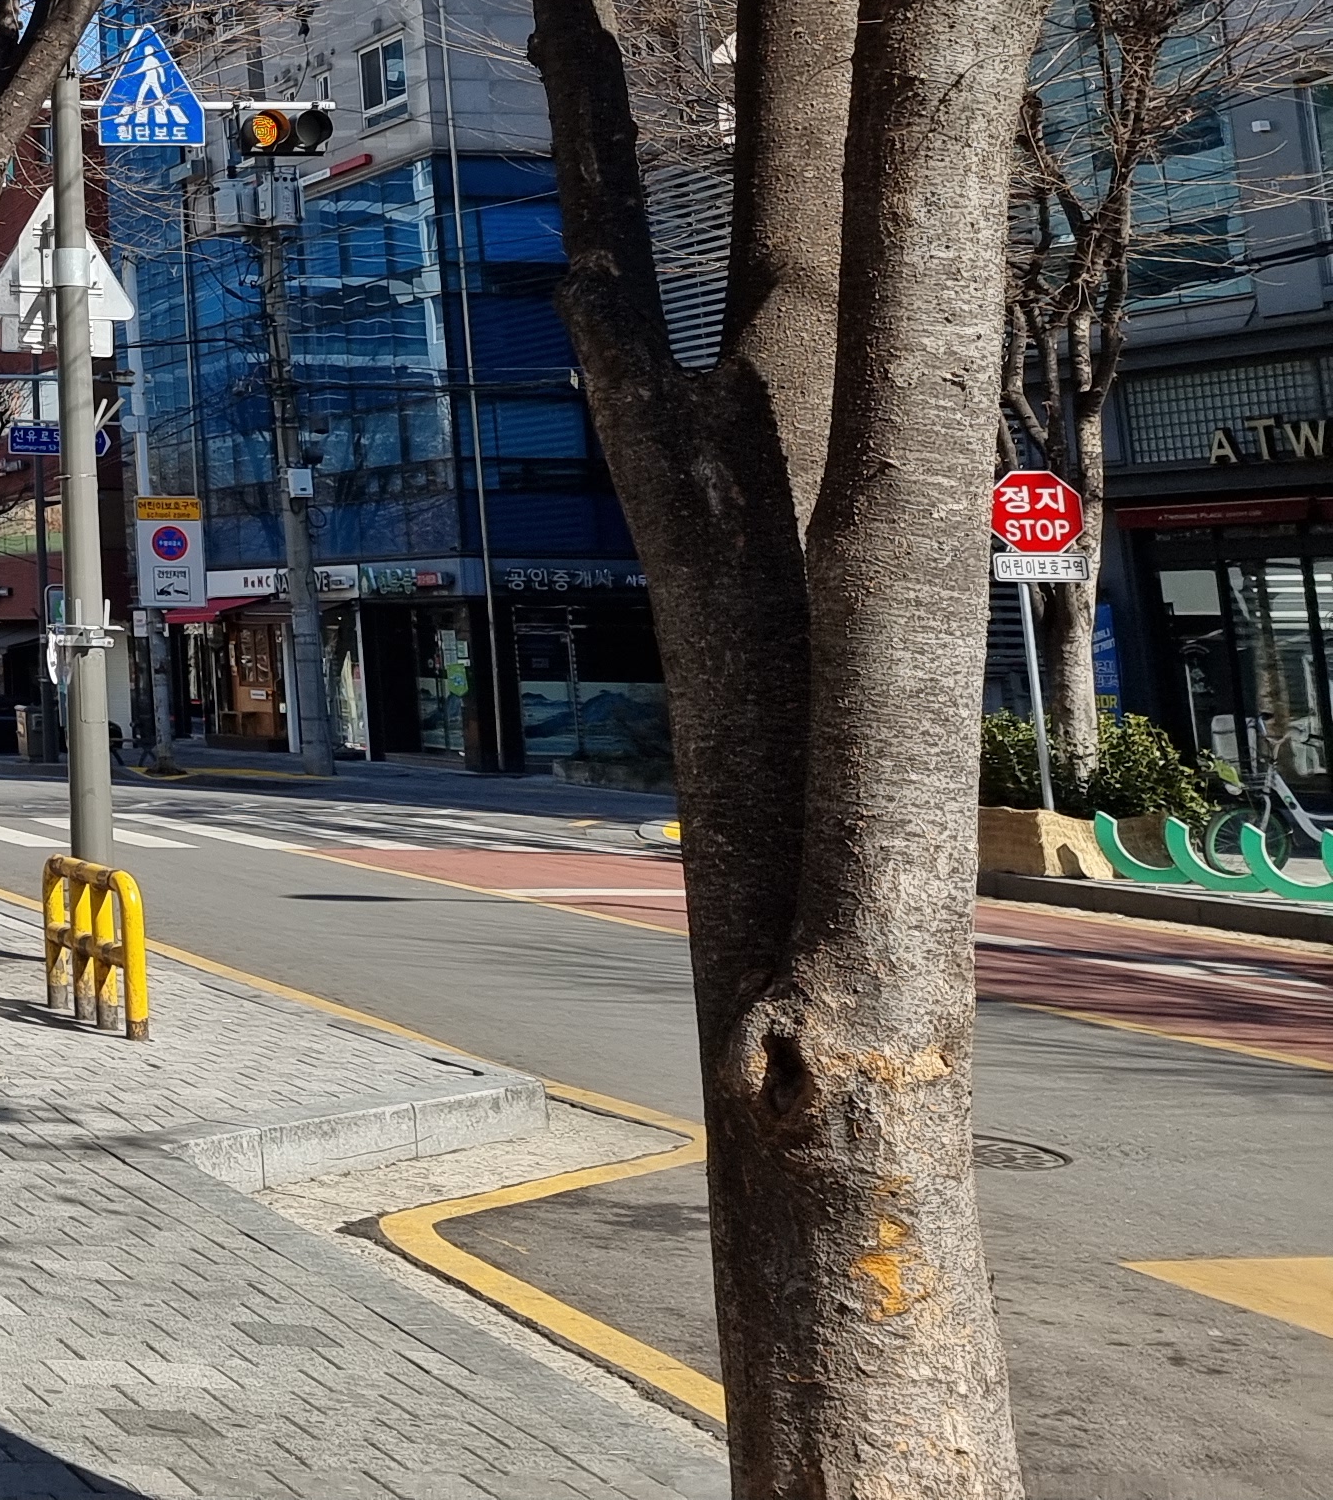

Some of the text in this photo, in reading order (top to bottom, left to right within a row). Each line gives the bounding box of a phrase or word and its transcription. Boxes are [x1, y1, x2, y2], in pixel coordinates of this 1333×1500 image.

[116, 125, 188, 141] 횡단보도
[138, 500, 199, 511] 어린이보호구역
[999, 485, 1066, 513] 정지
[1005, 519, 1070, 542] STOP
[1000, 558, 1085, 577] 어린이보호구역
